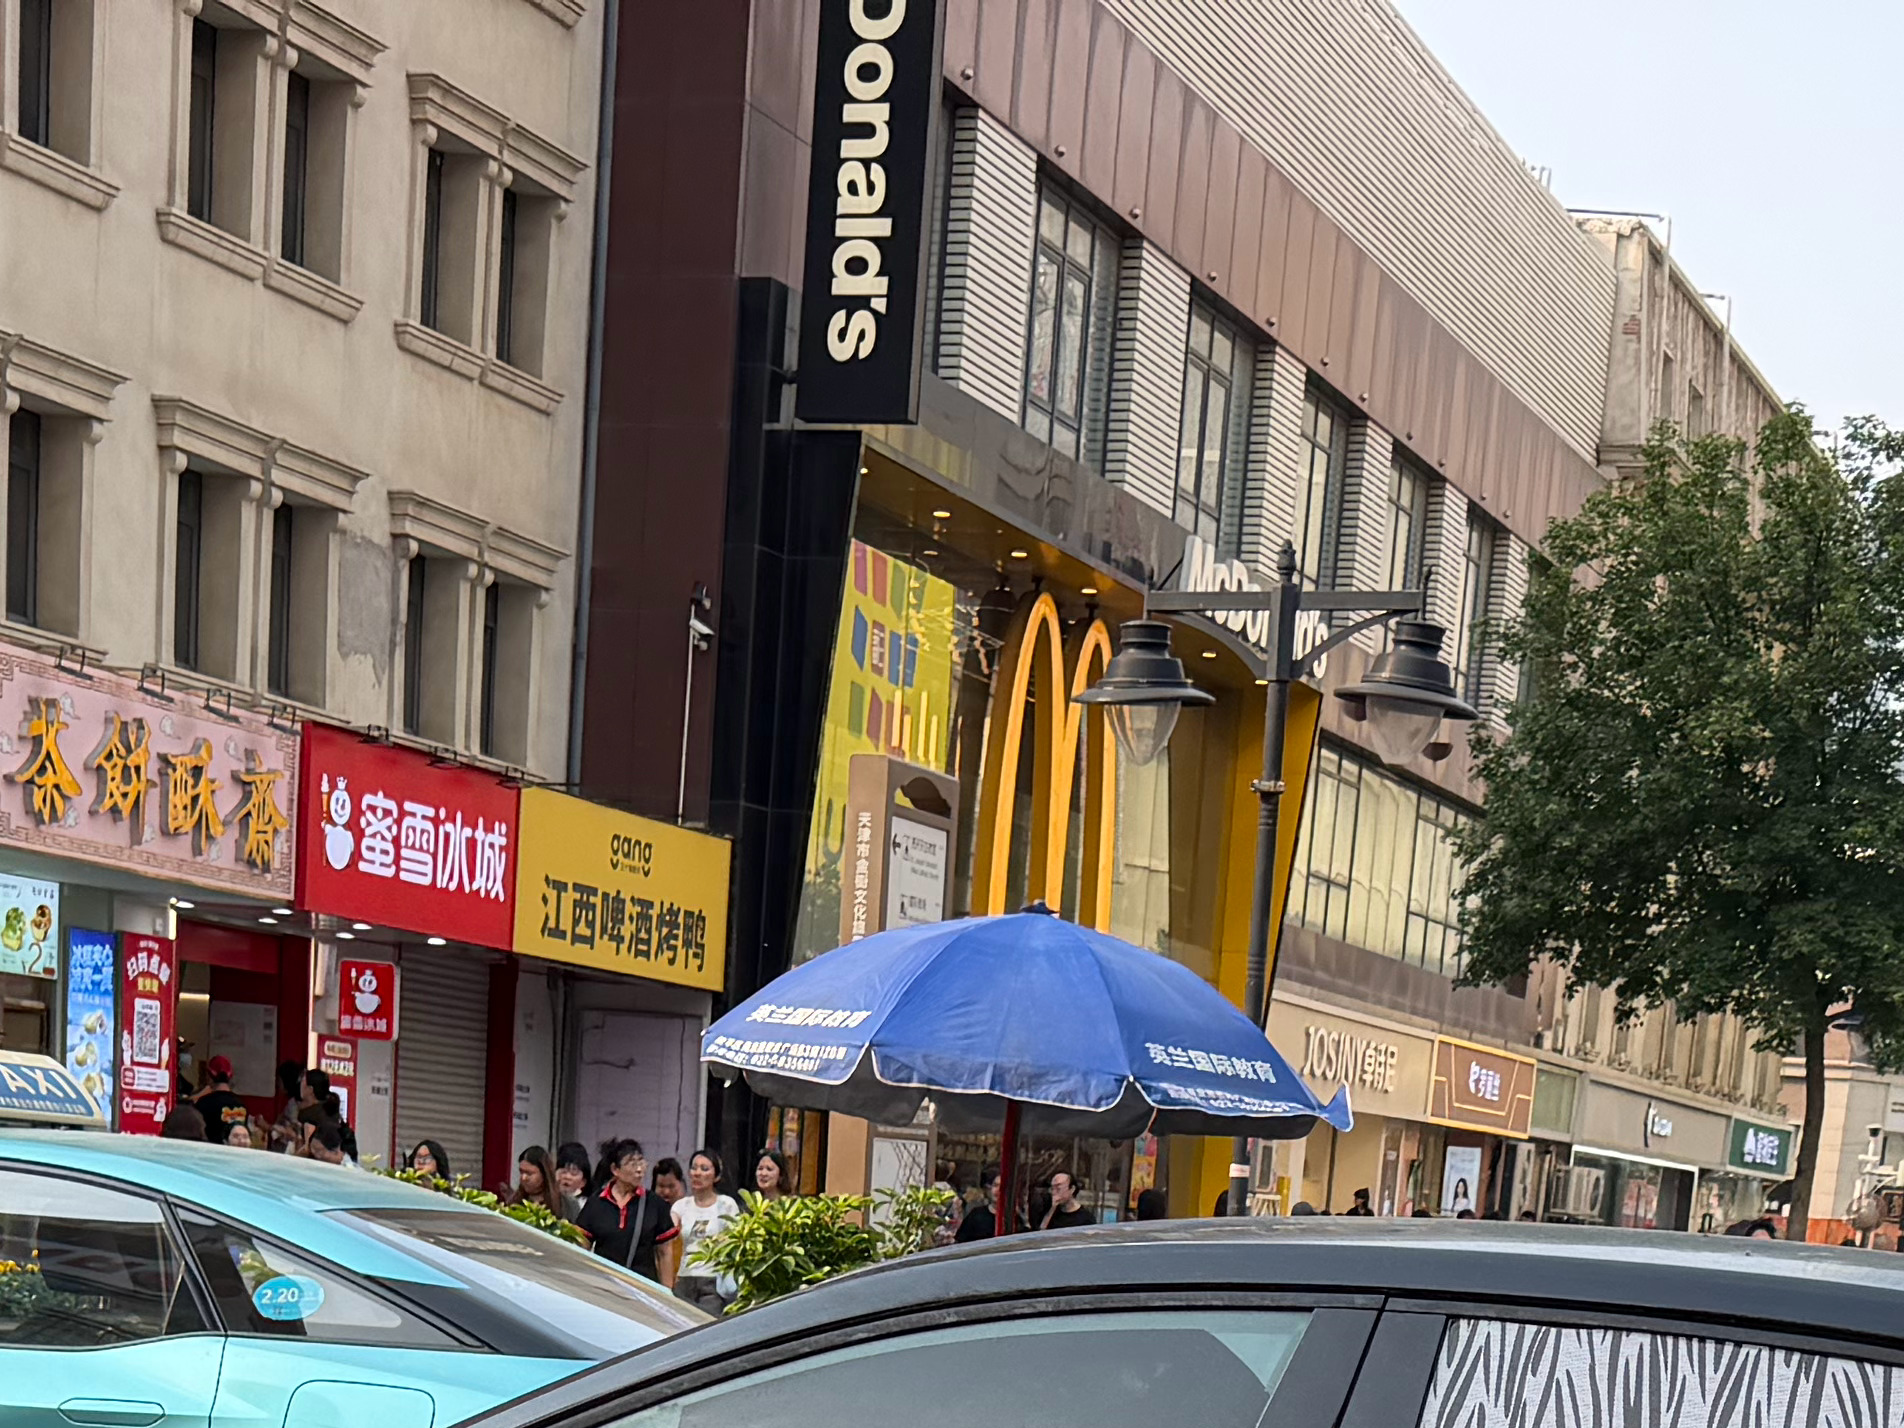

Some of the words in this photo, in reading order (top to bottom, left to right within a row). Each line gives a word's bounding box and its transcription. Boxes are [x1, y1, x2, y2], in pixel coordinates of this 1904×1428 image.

[358, 790, 508, 903] 蜜雪冰城
[610, 832, 653, 878] gang
[540, 873, 707, 973] 江西啤酒烤鸭
[1303, 1026, 1365, 1086] JOSINY
